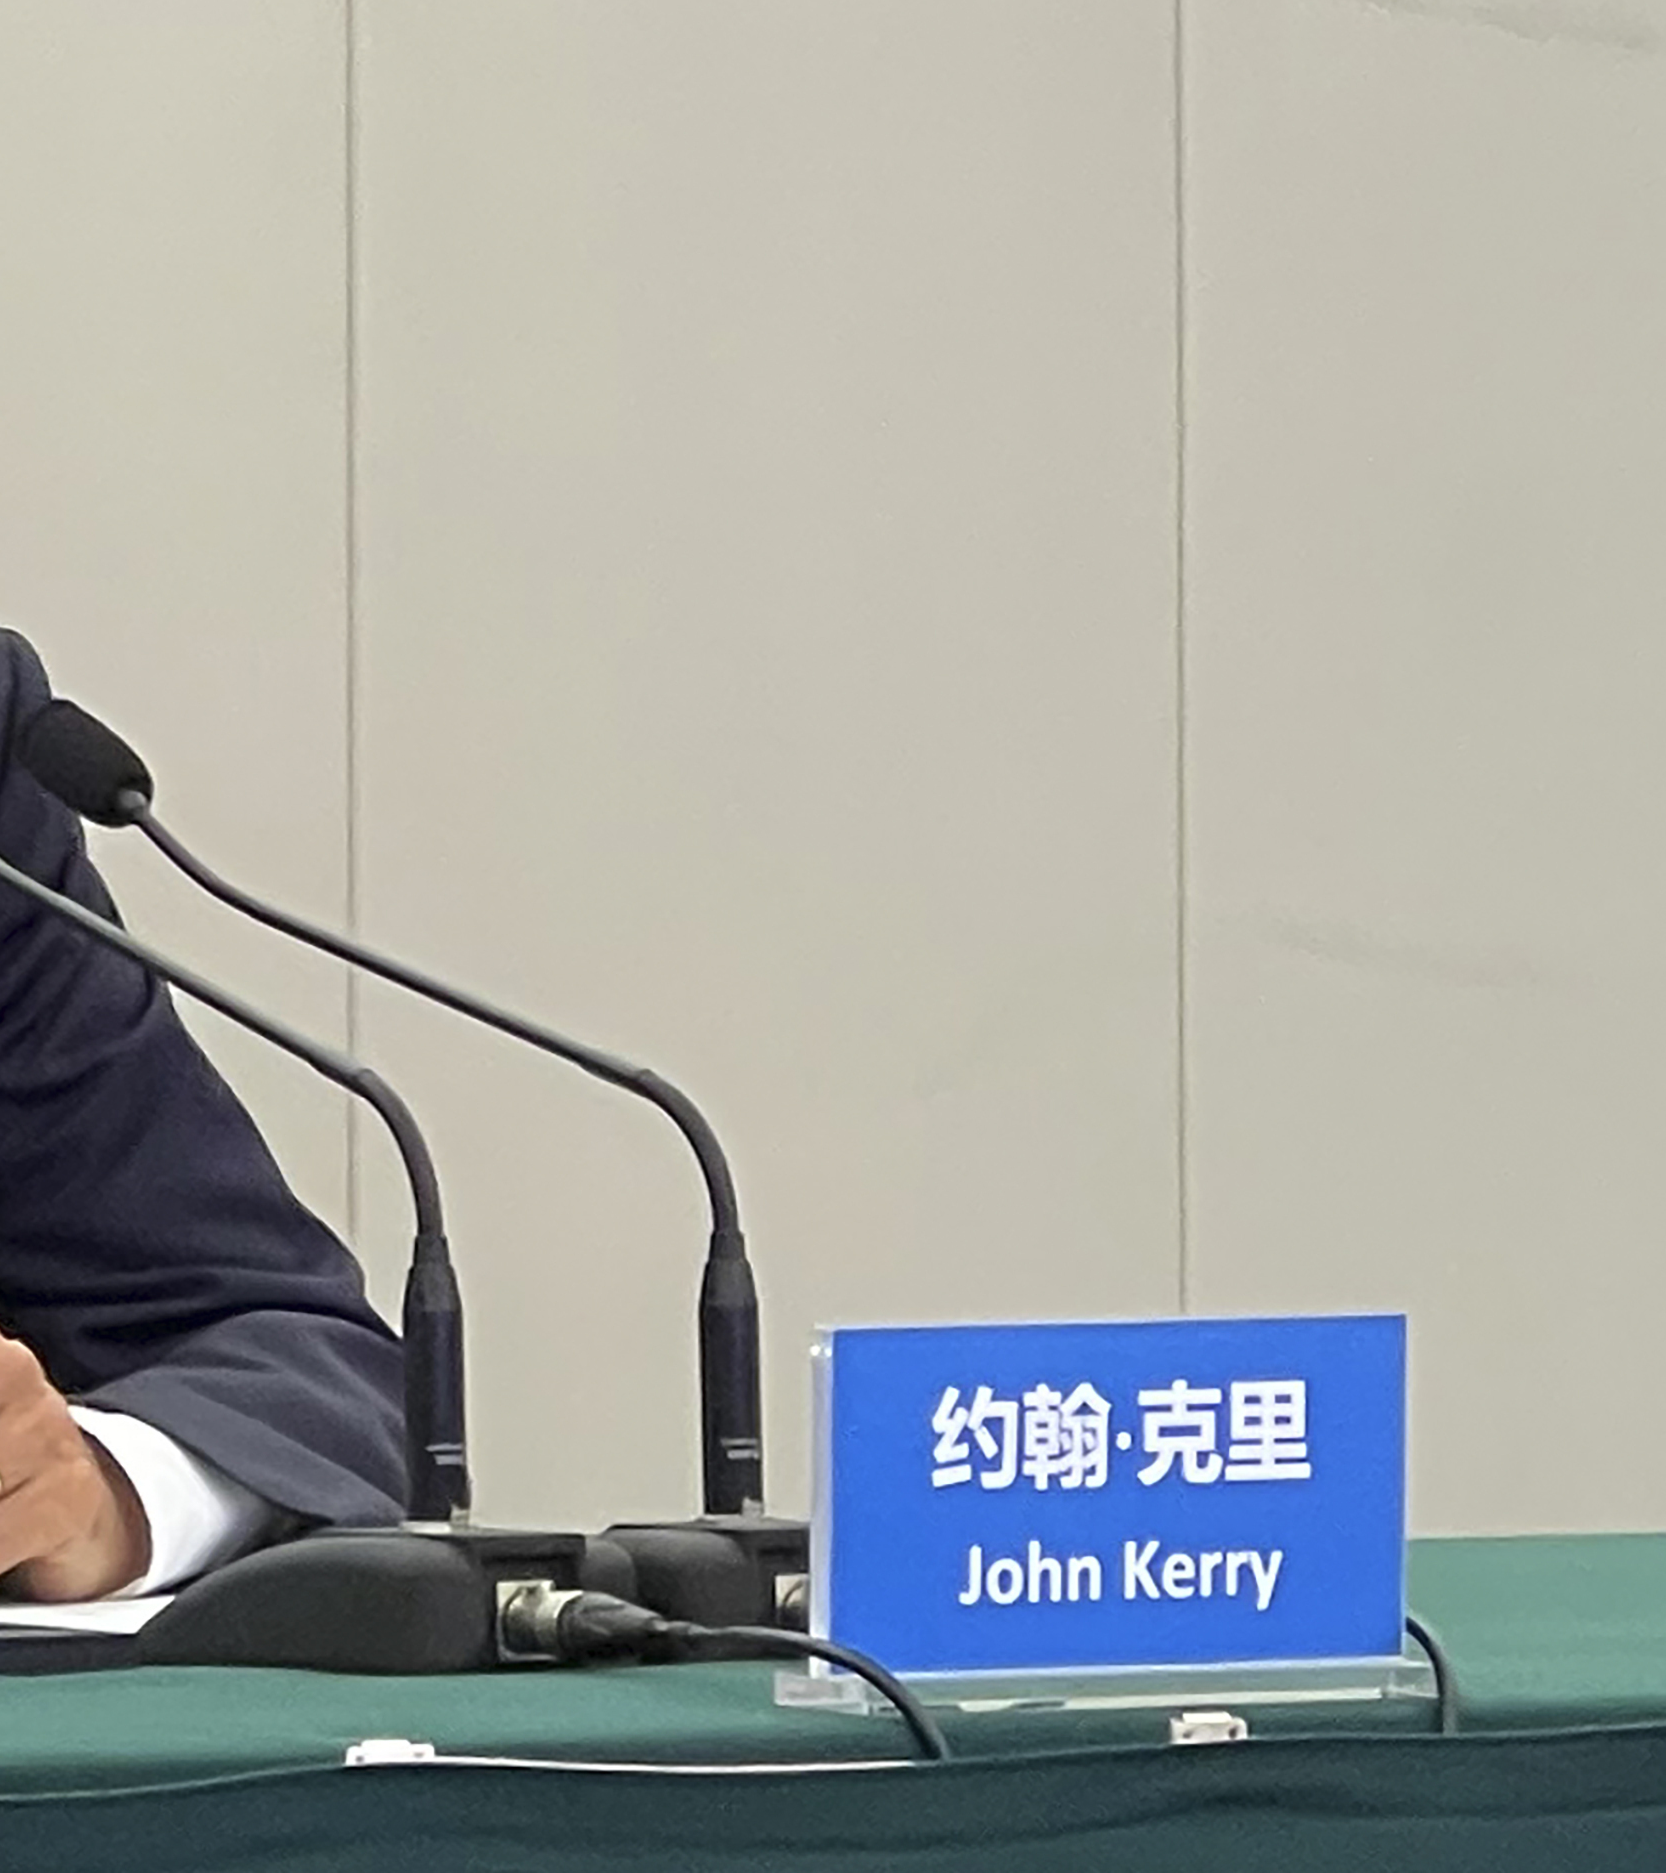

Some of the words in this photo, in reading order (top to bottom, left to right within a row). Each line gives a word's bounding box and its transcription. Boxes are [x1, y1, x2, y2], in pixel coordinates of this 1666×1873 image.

[930, 1378, 1313, 1491] 约翰·克里
[958, 1539, 1102, 1606] John
[1123, 1538, 1284, 1612] Kerry
